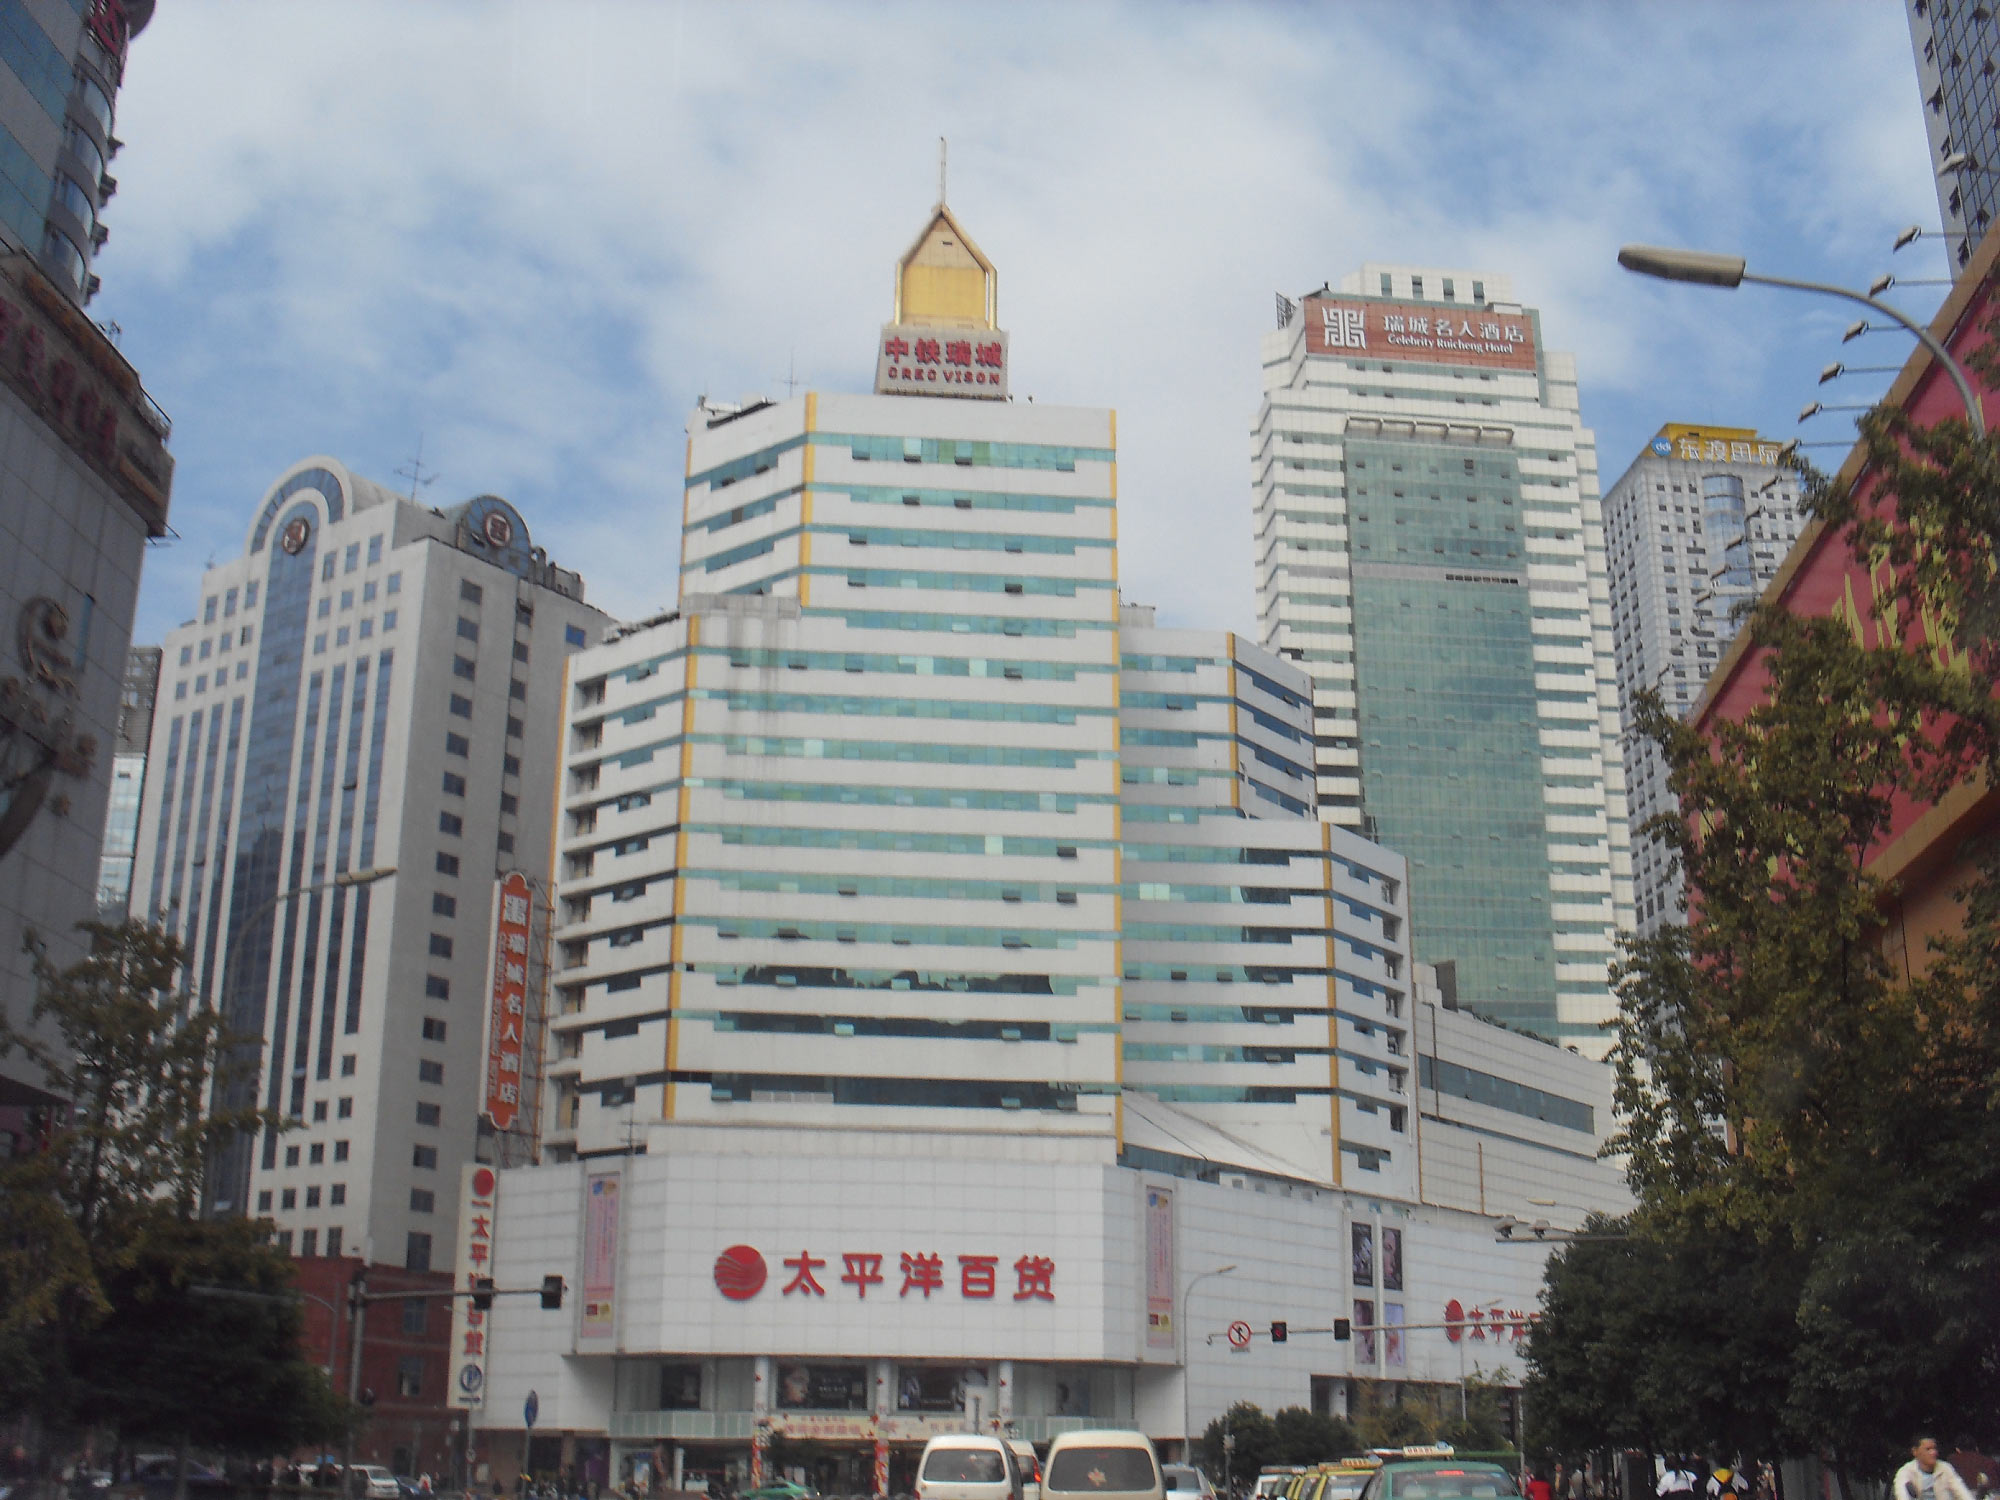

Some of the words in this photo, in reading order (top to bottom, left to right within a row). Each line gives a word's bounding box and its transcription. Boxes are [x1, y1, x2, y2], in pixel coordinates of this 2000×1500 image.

[1383, 315, 1524, 343] 瑞城名人酒店
[1387, 333, 1434, 349] Celebrity
[1436, 338, 1483, 354] Ruicheng
[1484, 341, 1513, 354] Hotel
[885, 336, 1003, 368] 中铁瑞城
[782, 1250, 1055, 1301] 太平洋百货
